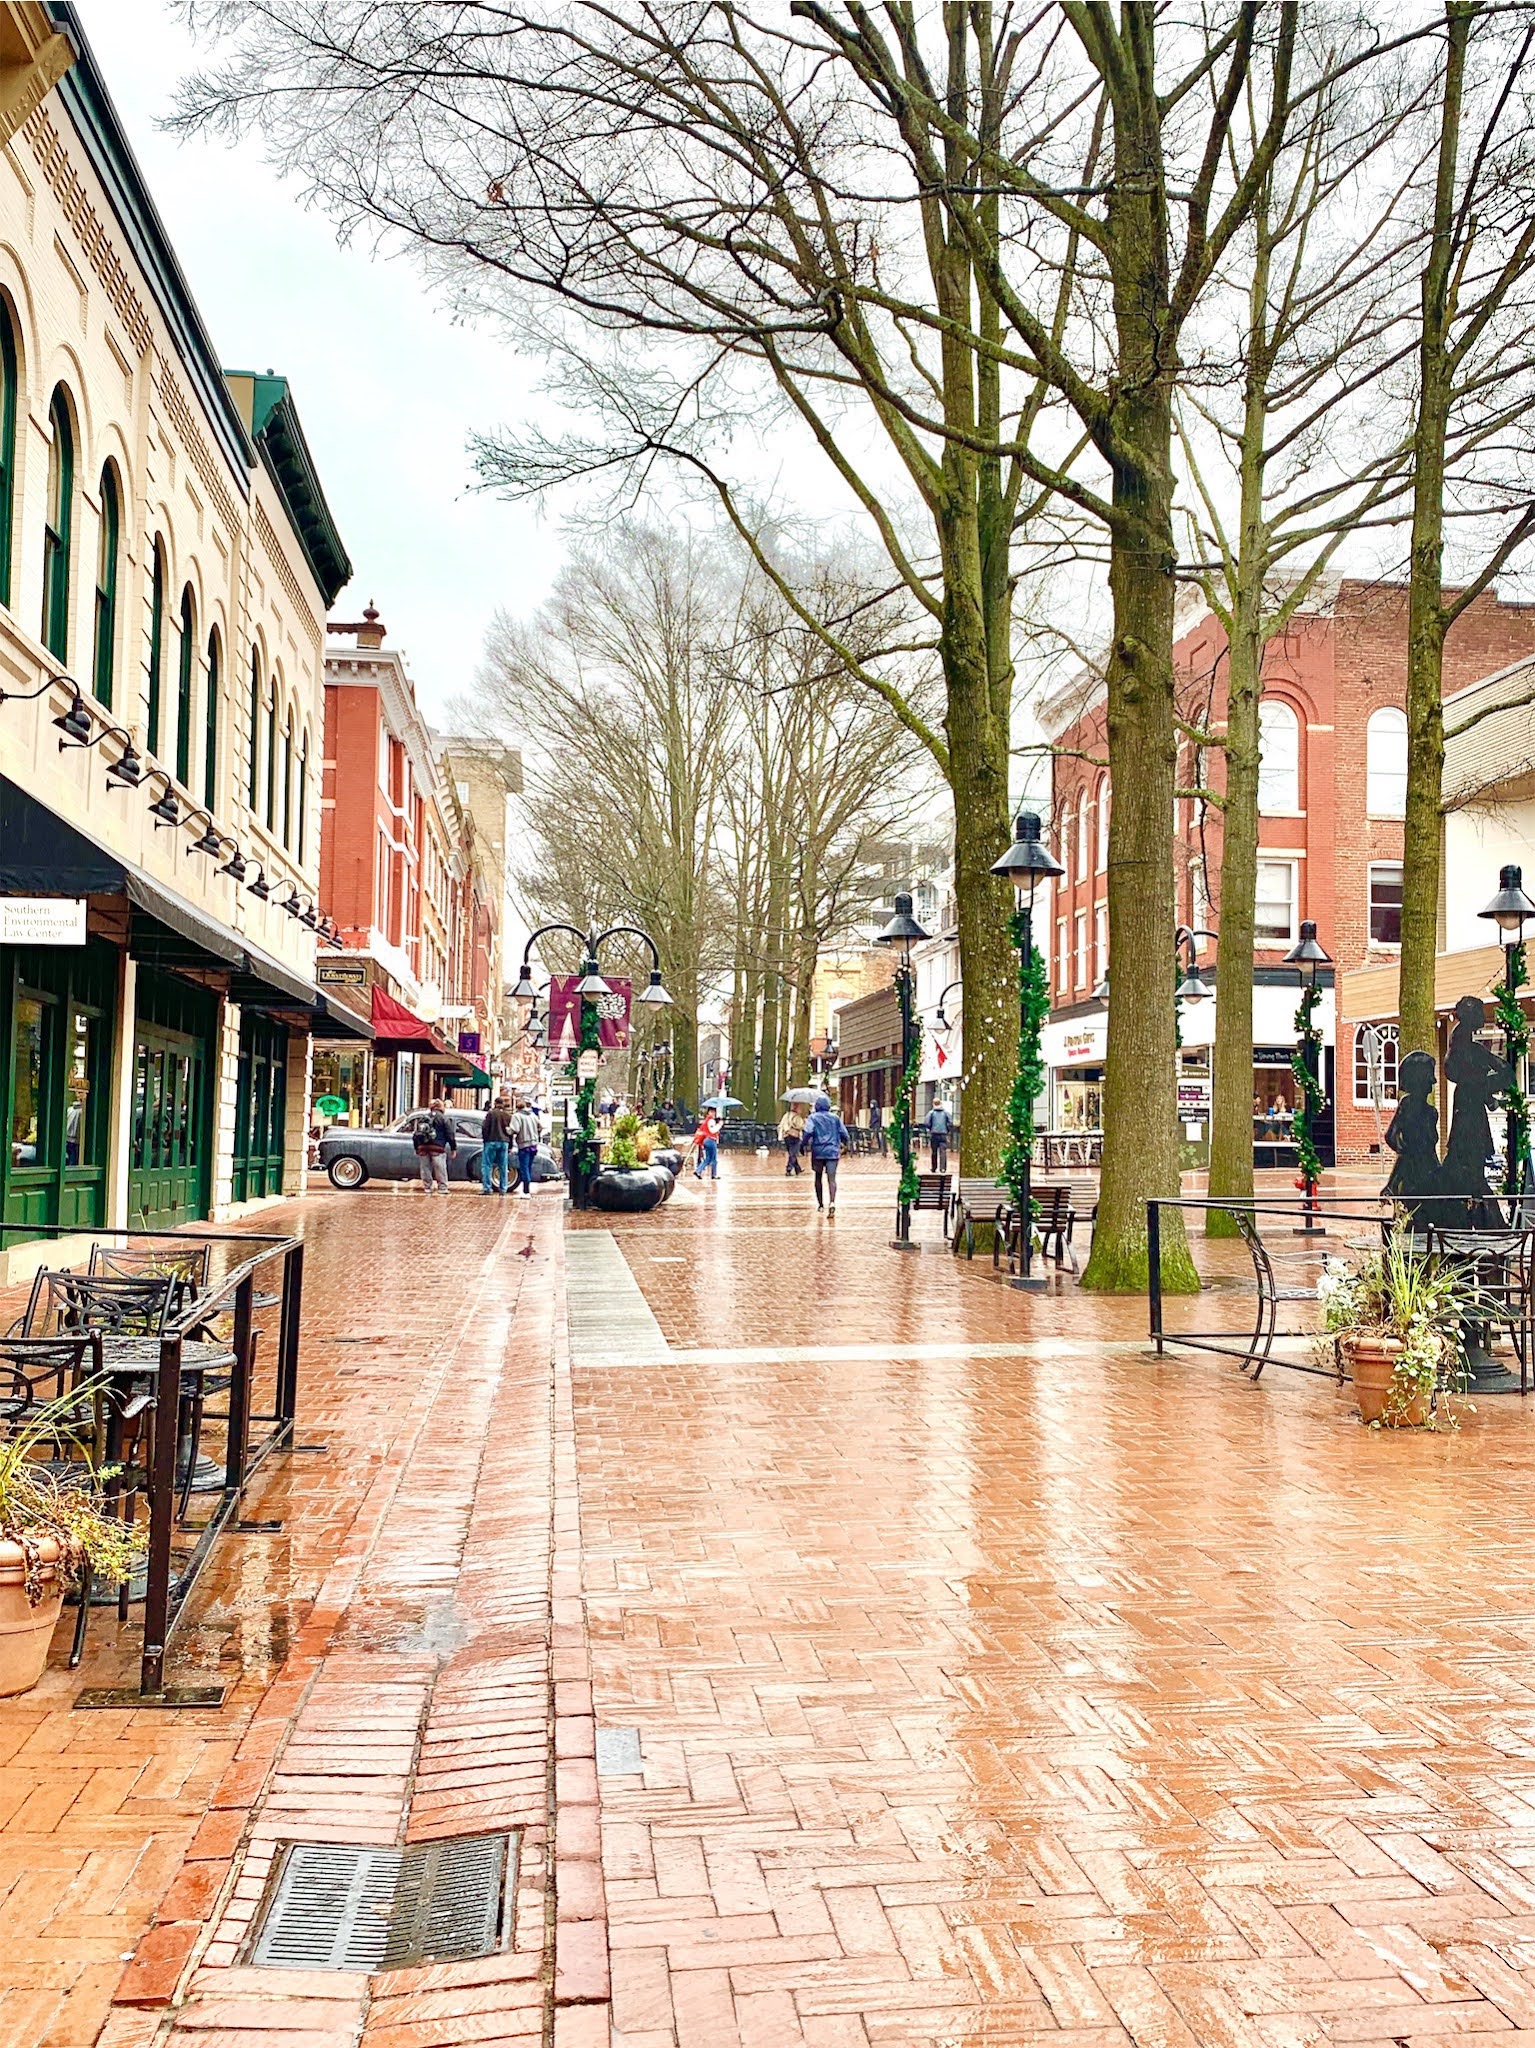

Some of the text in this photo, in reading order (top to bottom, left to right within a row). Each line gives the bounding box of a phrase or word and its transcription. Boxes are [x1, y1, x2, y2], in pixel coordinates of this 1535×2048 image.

[4, 904, 51, 915] Southern
[4, 916, 78, 927] Environmental
[4, 927, 64, 938] Law Center
